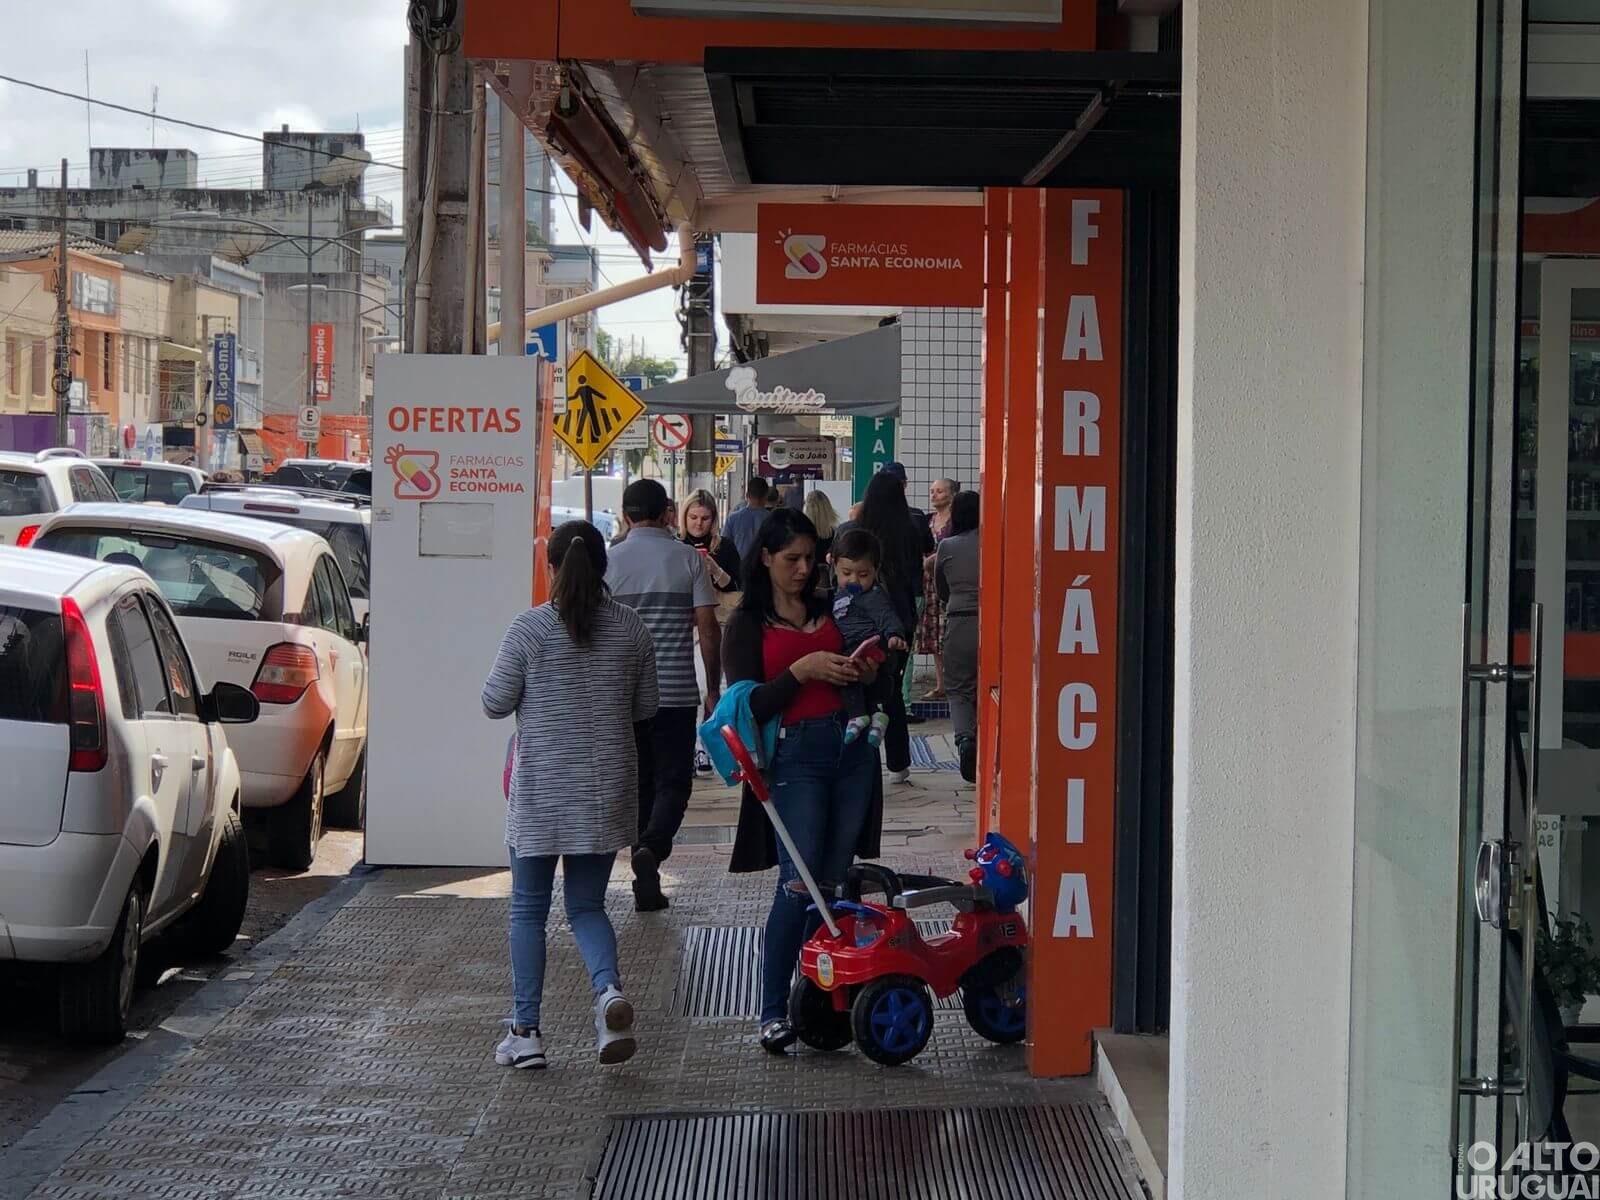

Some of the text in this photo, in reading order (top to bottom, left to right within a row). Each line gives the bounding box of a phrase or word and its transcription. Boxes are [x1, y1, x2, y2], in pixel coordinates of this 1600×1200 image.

[830, 241, 908, 255] FARMÁCIAS
[830, 257, 963, 270] SANTA ECONOMIA
[306, 410, 314, 422] E
[388, 406, 522, 433] OFERTAS
[450, 453, 524, 467] FARMÁCIAS
[450, 468, 497, 479] SANTA
[450, 482, 524, 493] ECONOMIA
[1052, 199, 1107, 939] FARMÁCIA
[1001, 924, 1016, 937] 12
